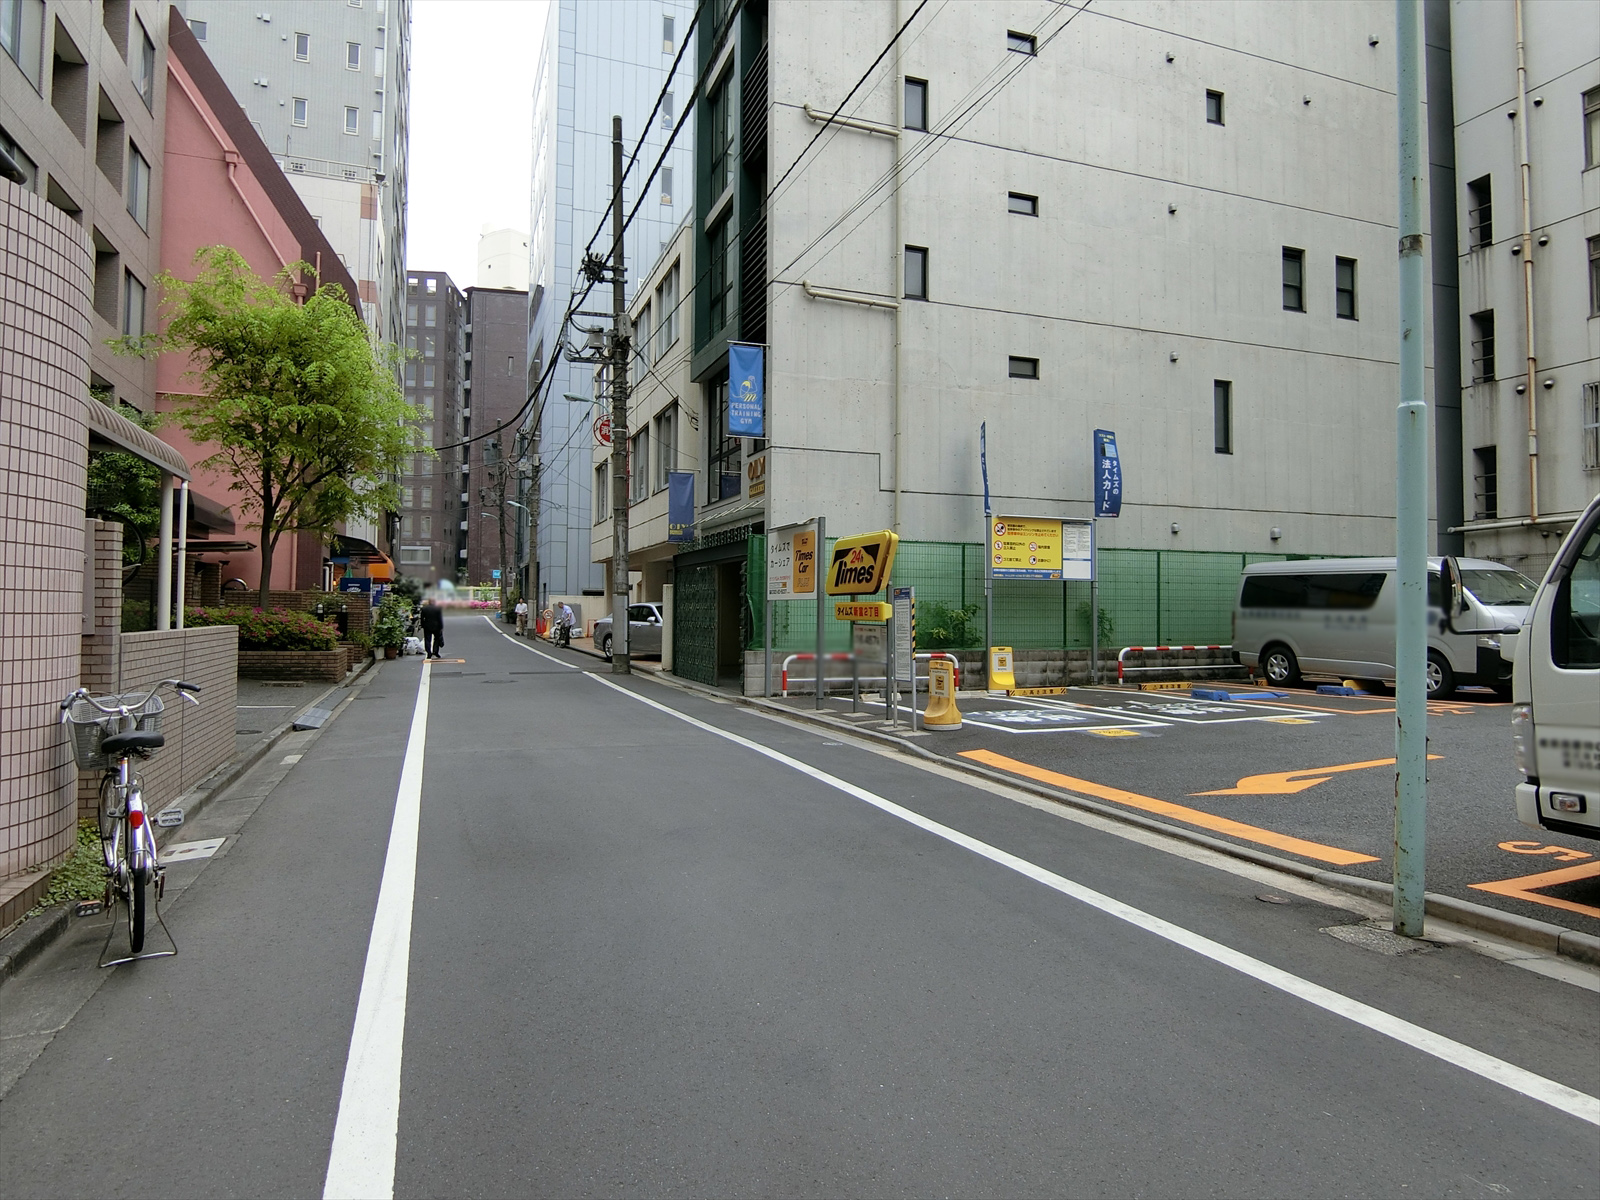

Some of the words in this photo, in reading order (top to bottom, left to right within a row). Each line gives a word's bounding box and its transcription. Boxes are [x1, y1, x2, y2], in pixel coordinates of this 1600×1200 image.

[731, 402, 761, 410] PERSONAL
[731, 410, 761, 418] TRAINING
[1101, 459, 1111, 511] 法人カード
[770, 542, 790, 554] タイムズで
[795, 550, 813, 561] Times
[770, 557, 790, 568] カーシェア
[798, 561, 809, 573] Car
[834, 560, 875, 588] Times
[1497, 840, 1593, 861] 5
